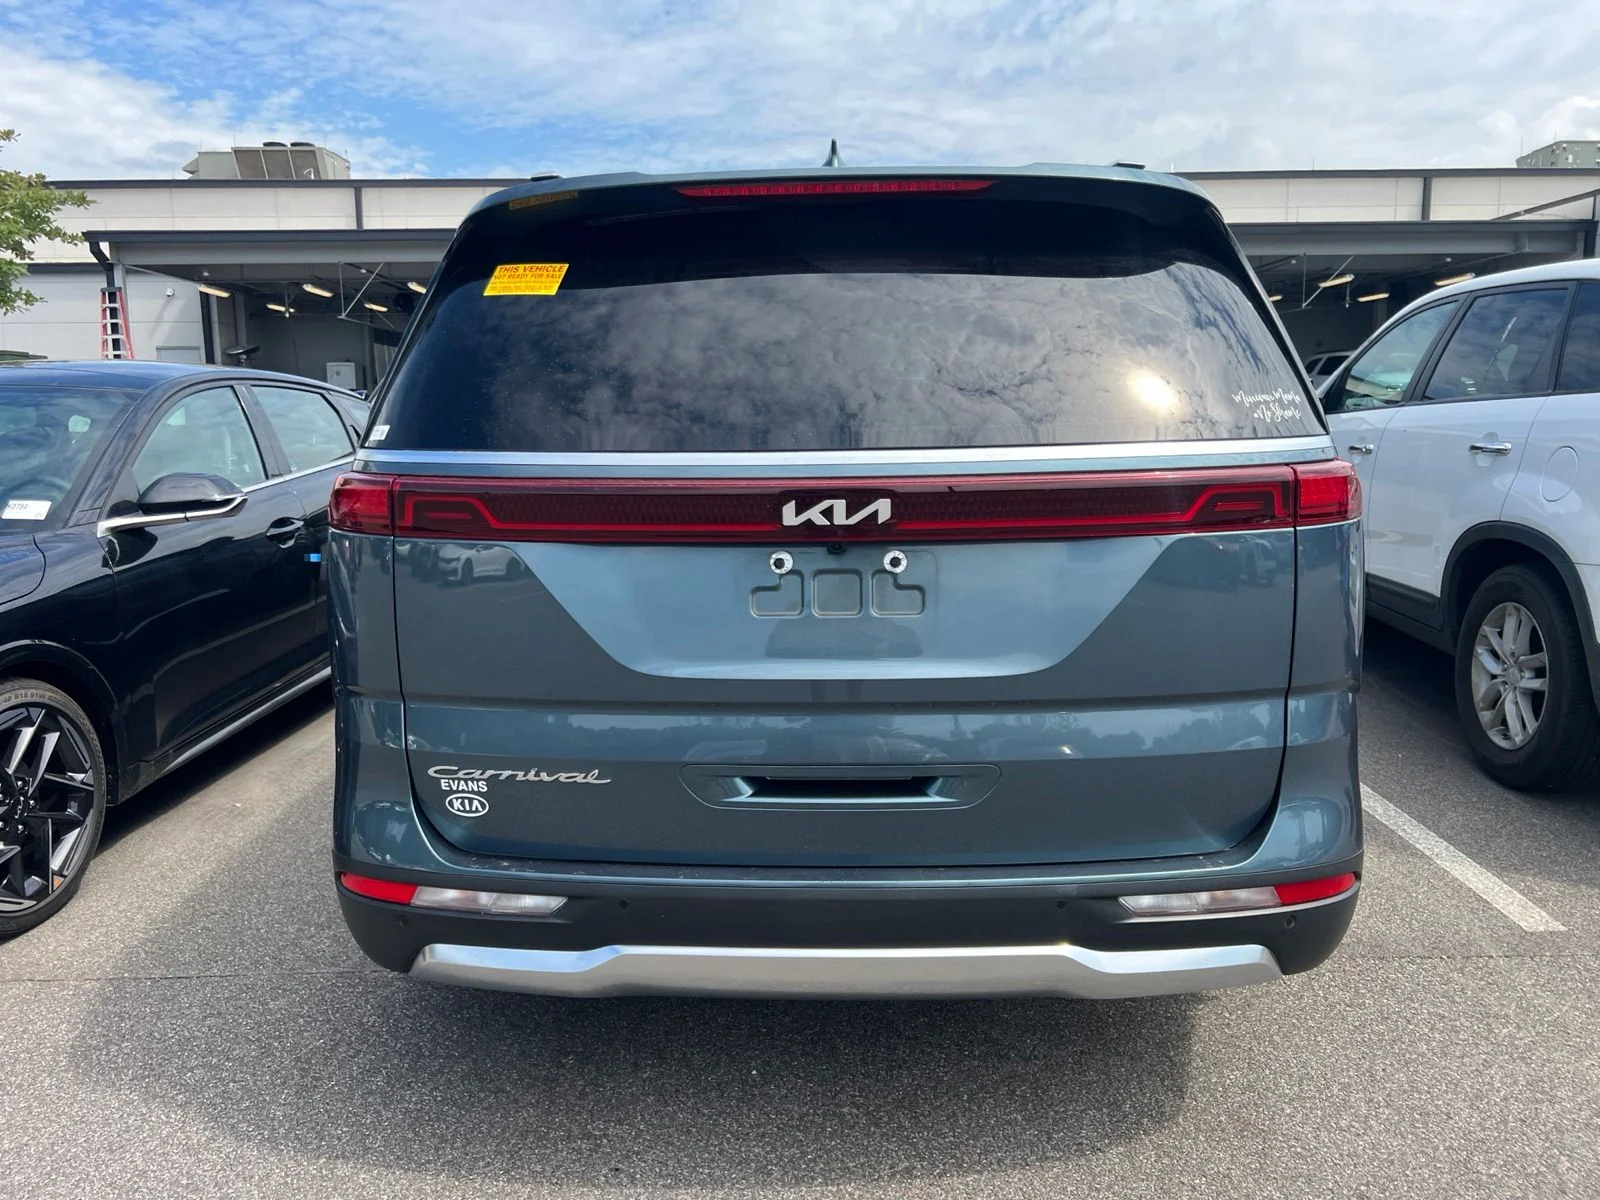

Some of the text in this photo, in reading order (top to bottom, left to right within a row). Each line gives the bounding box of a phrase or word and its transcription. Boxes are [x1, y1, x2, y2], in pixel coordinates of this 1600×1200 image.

[523, 265, 566, 273] VEHICLE
[427, 765, 612, 784] Carnival
[440, 779, 488, 793] EVANS
[452, 798, 483, 812] KIA
